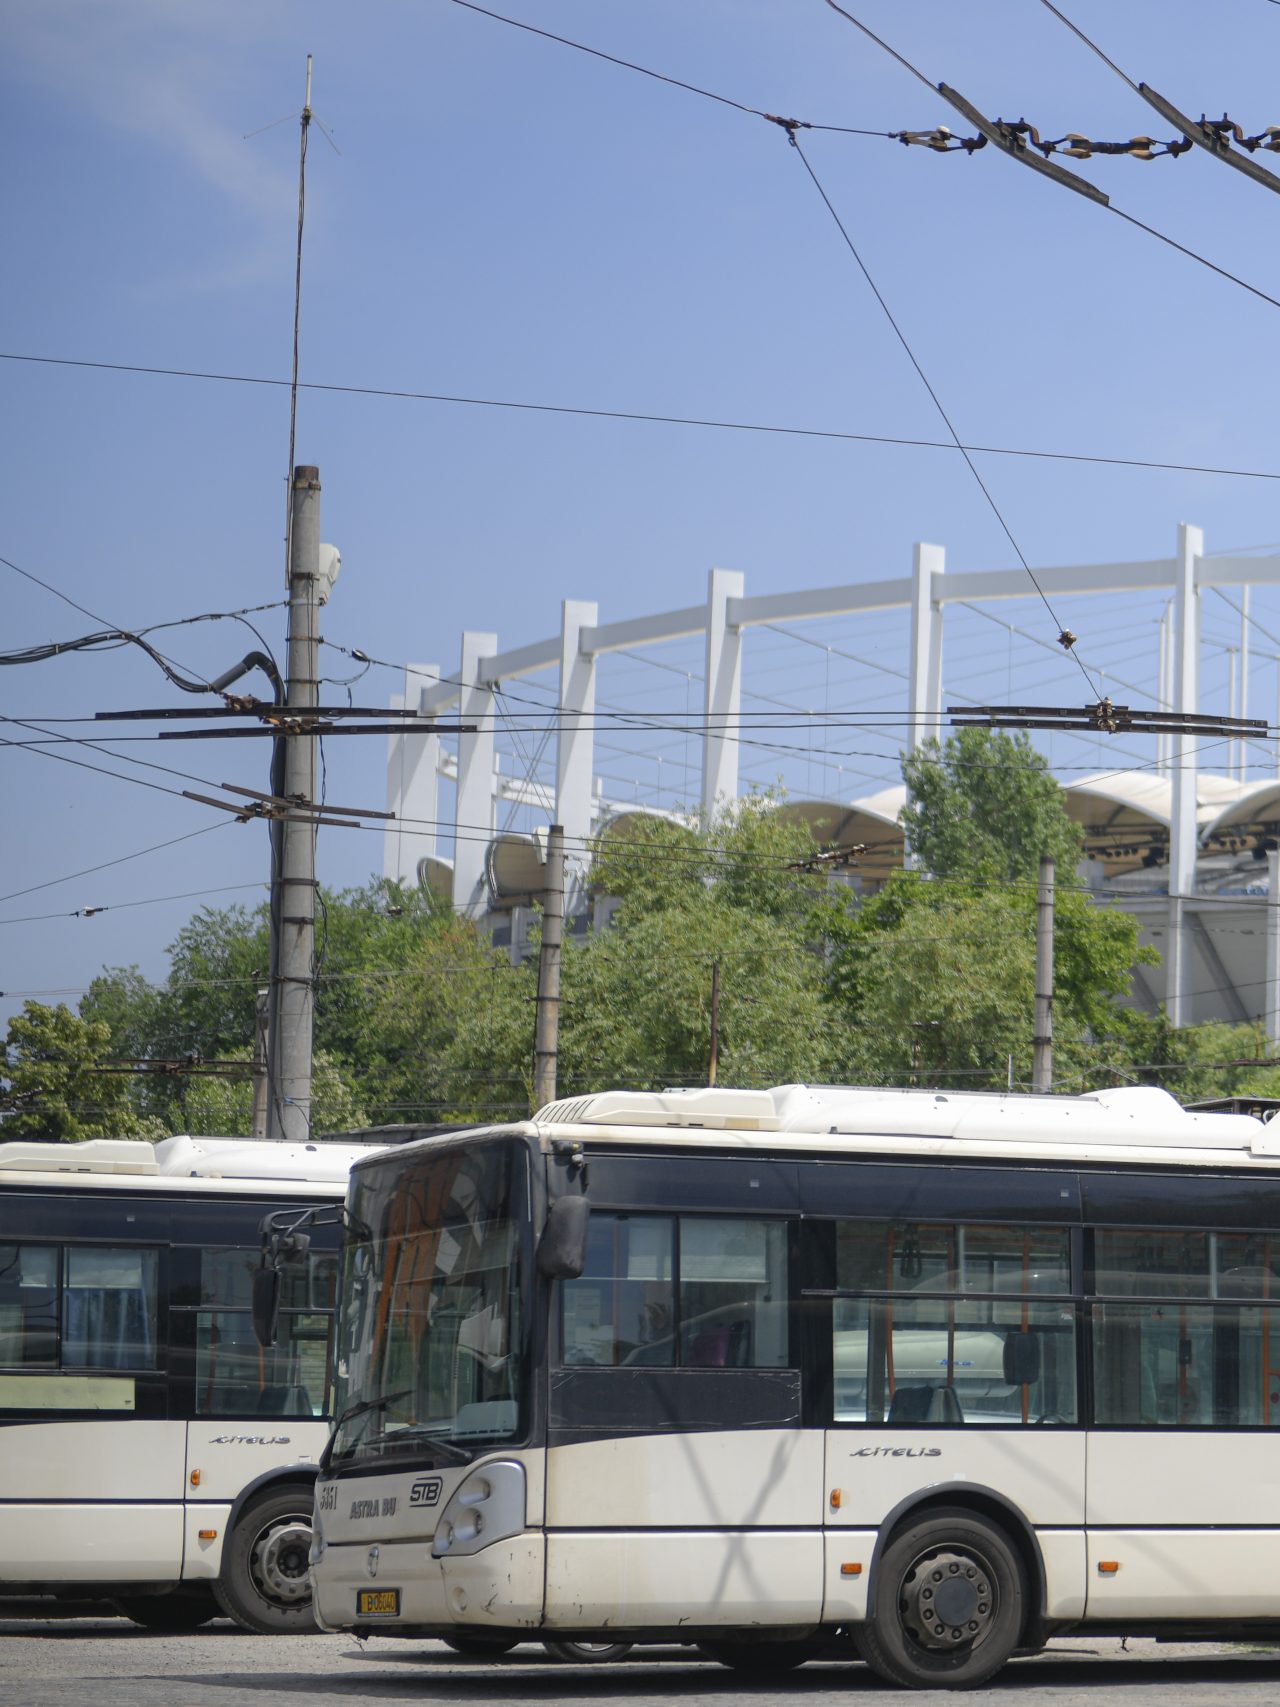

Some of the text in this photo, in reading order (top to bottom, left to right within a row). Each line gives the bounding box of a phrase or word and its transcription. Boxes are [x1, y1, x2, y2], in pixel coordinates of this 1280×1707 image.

[849, 1447, 942, 1457] CITELIS
[410, 1480, 441, 1503] STB
[350, 1497, 397, 1520] ASTRA BU
